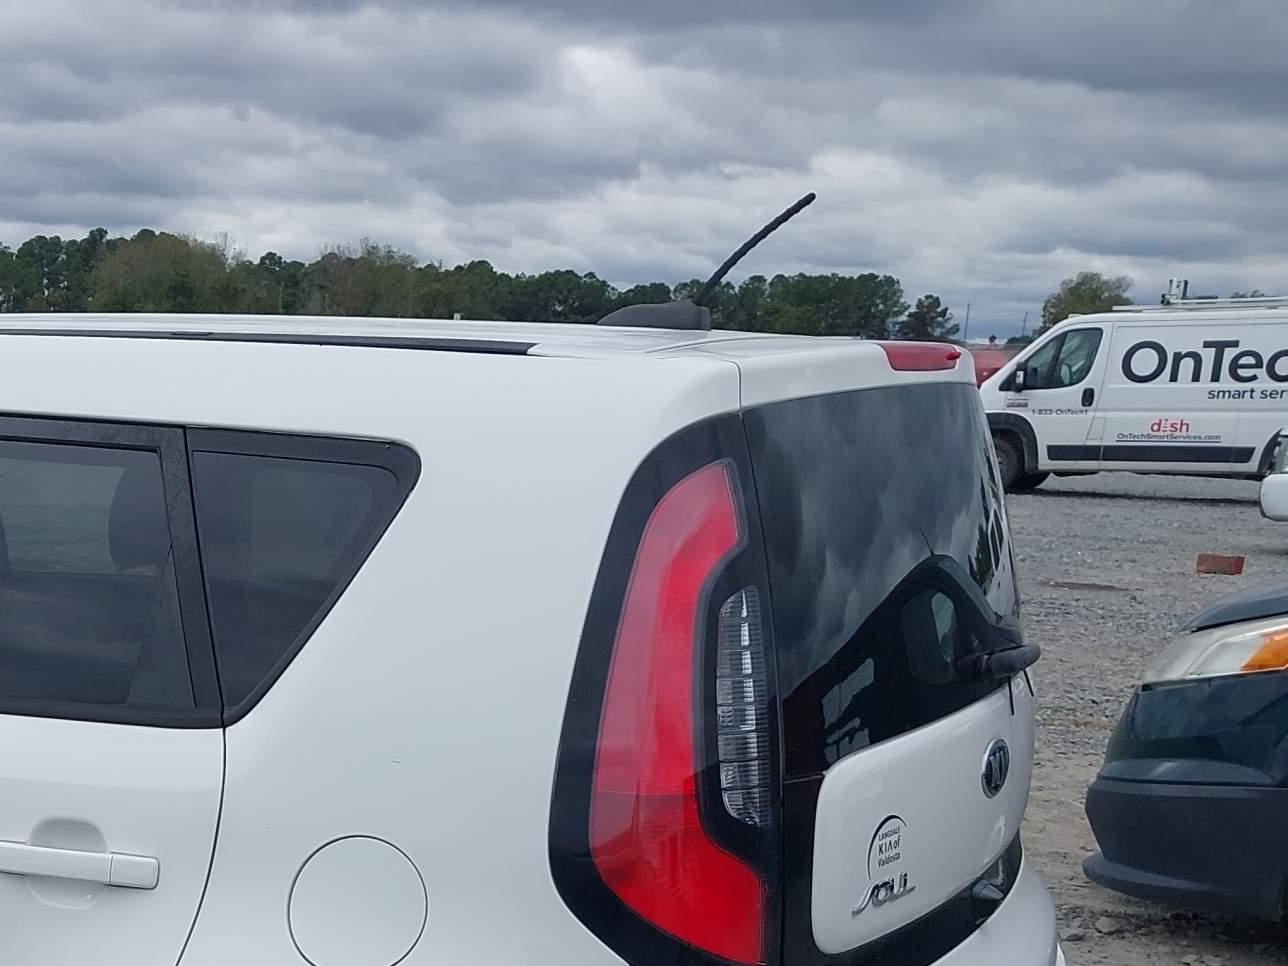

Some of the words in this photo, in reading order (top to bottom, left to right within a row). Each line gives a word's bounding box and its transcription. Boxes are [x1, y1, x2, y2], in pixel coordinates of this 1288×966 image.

[1208, 387, 1256, 400] smart
[1150, 419, 1190, 433] dish
[1117, 433, 1221, 441] OnTechSmartServices.com
